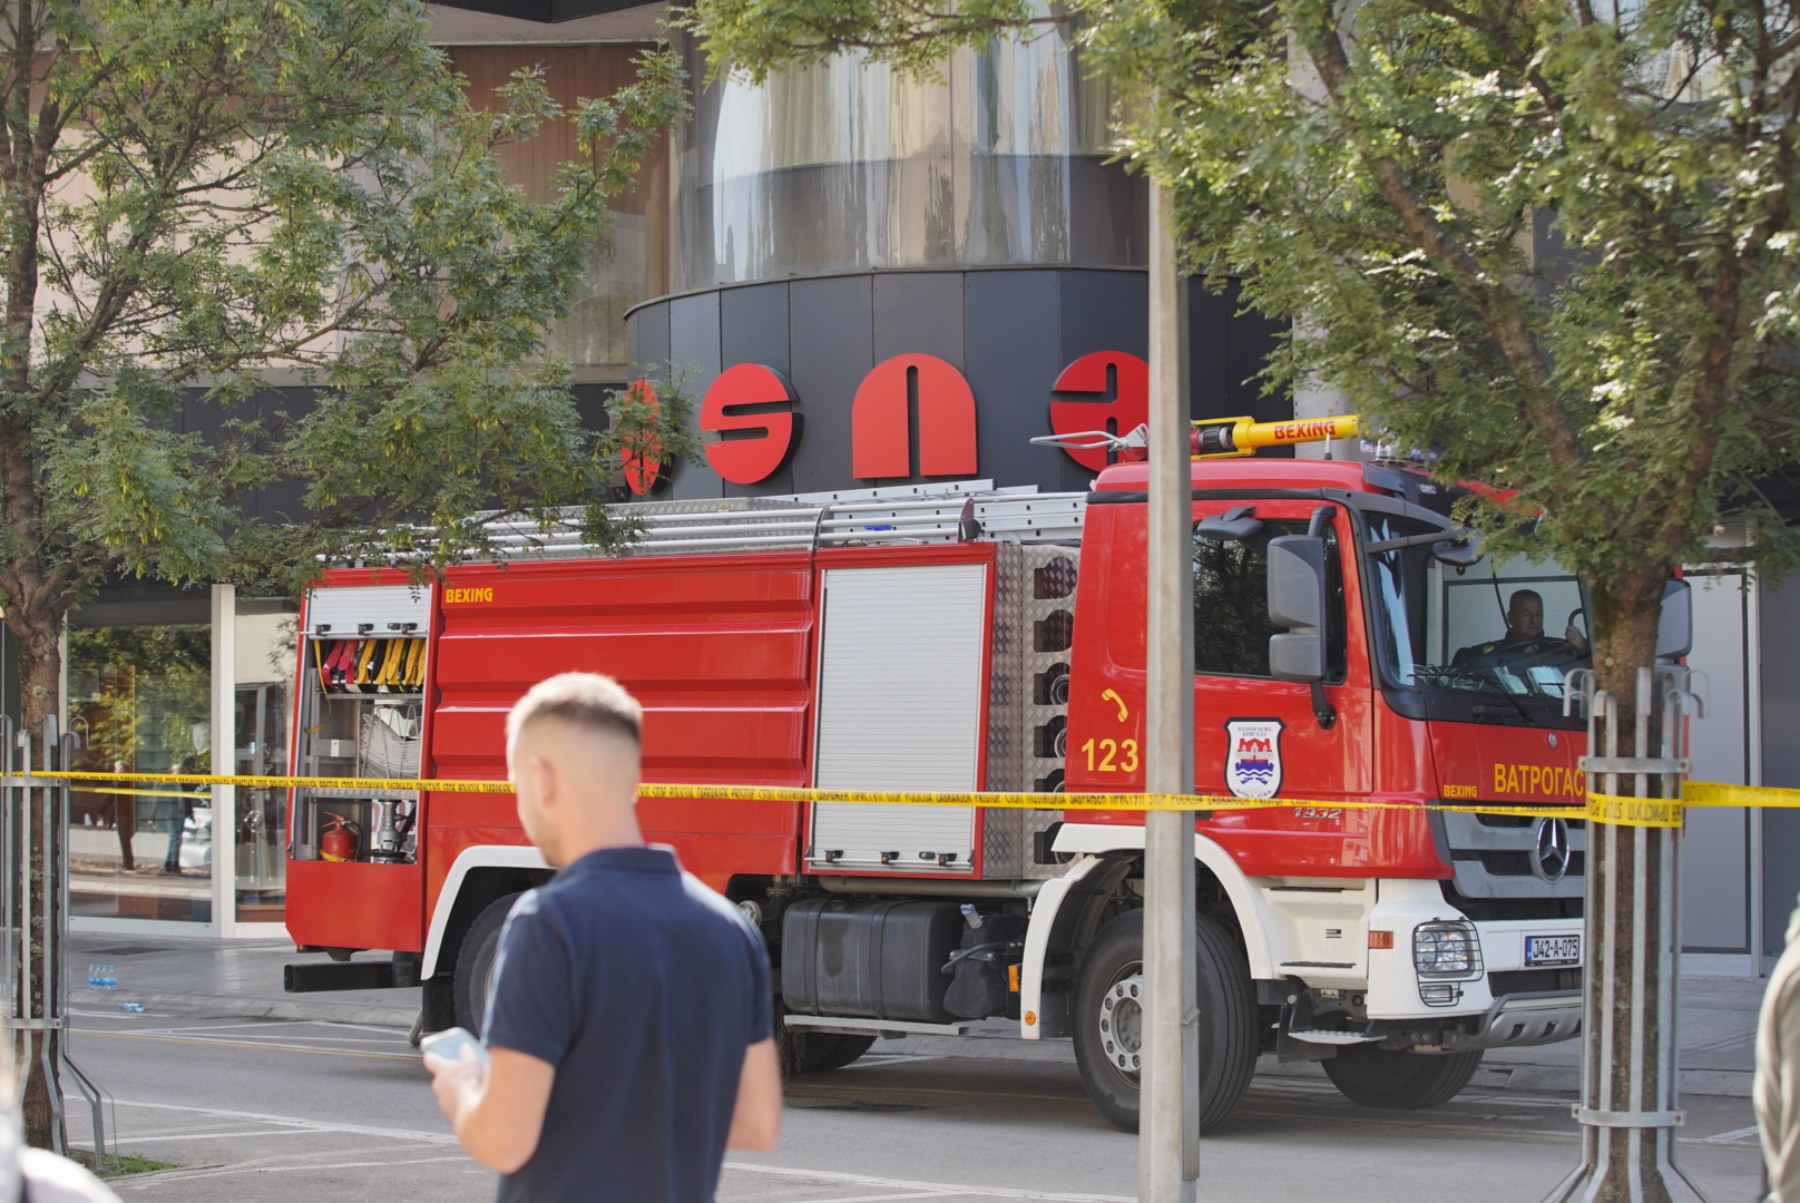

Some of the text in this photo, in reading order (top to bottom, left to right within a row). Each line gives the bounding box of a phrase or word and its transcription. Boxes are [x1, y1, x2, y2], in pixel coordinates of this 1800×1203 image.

[1274, 421, 1336, 440] BEXING
[446, 588, 493, 603] BEXING
[1081, 738, 1139, 773] 123
[1494, 763, 1584, 796] ВАТРОГАС
[1443, 785, 1477, 798] BEXING
[1294, 807, 1343, 819] 1932
